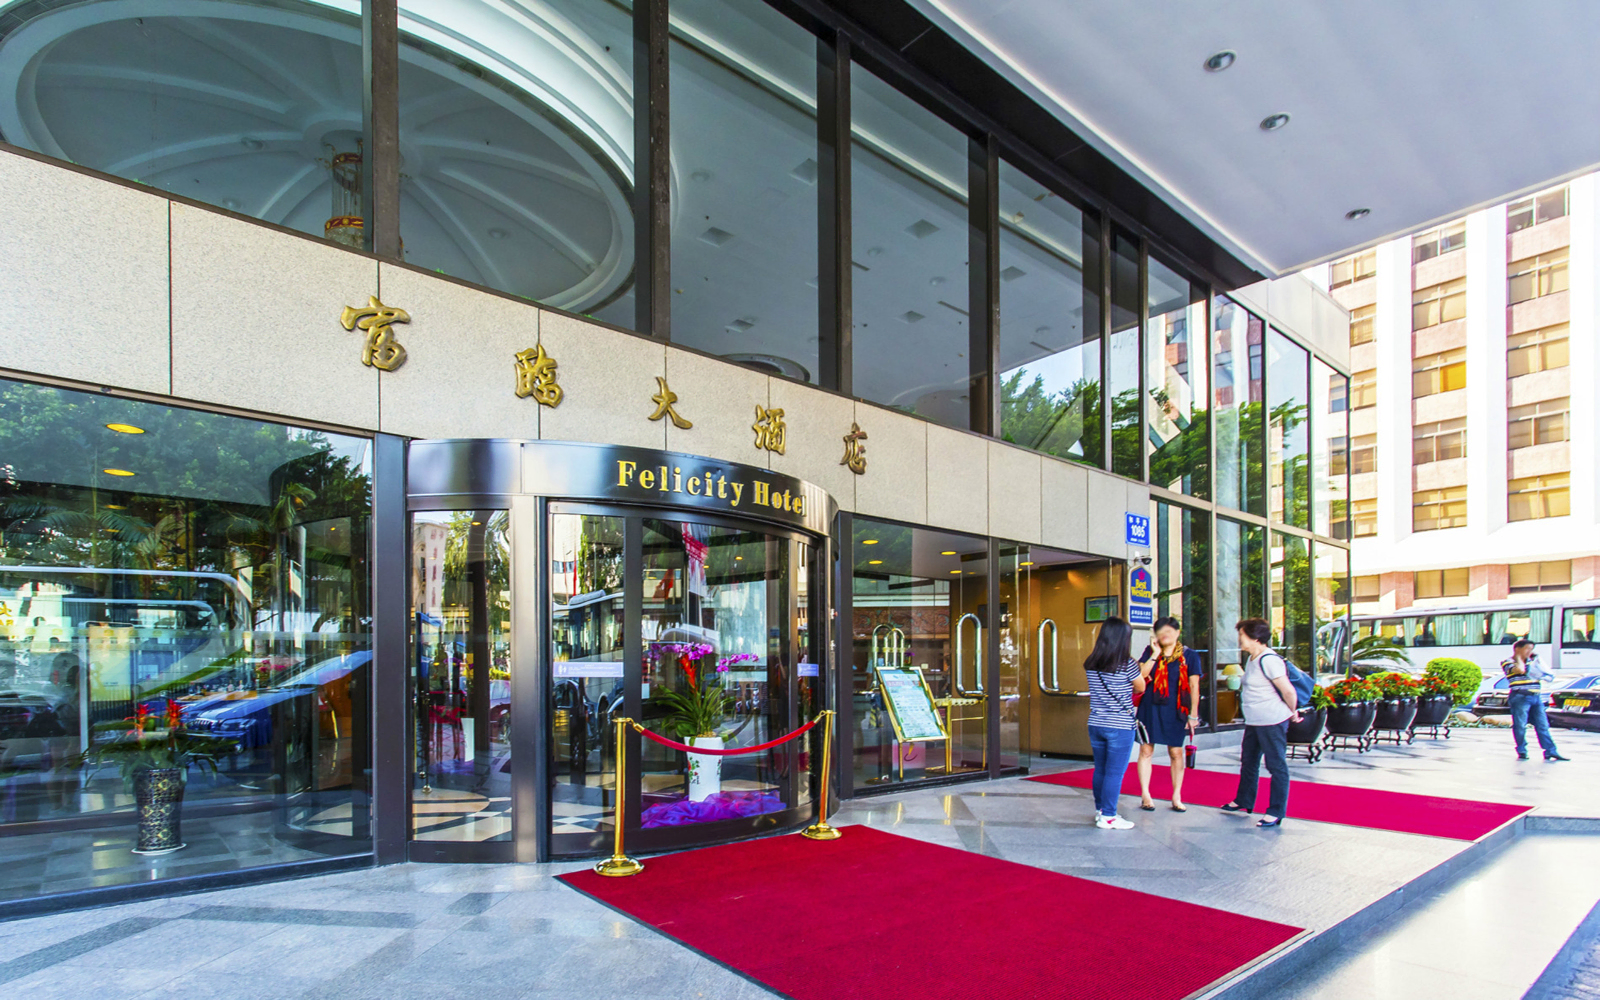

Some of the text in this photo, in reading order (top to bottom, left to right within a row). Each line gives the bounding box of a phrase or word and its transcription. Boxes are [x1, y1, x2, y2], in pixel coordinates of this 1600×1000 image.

[617, 460, 807, 517] Felicity Hotel
[1135, 579, 1147, 590] Best
